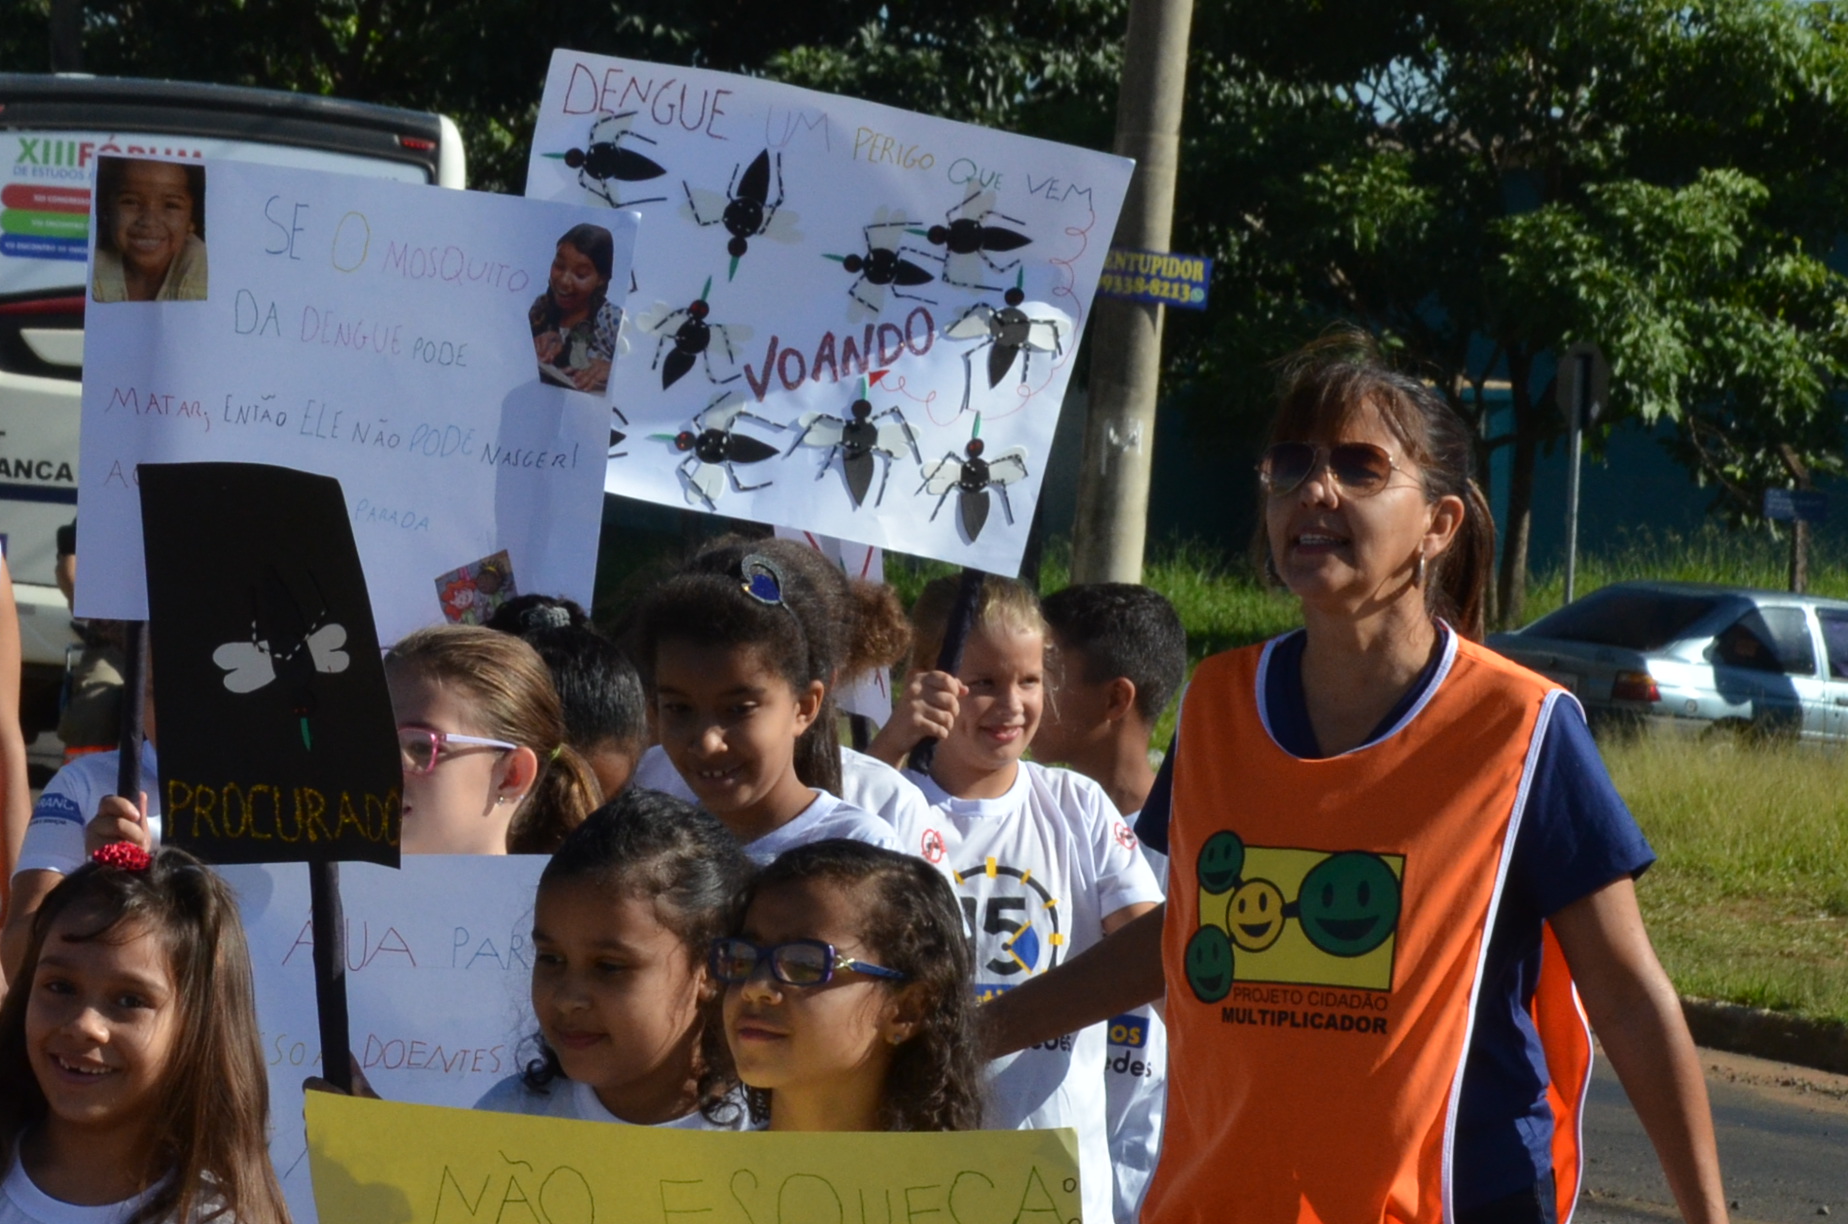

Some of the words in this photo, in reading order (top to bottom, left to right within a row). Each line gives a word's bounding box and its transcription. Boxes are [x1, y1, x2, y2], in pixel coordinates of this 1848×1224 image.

[563, 62, 732, 140] DENGUE
[765, 105, 831, 152] UM
[852, 127, 936, 171] PERIGO
[948, 158, 1004, 192] QUE
[1027, 173, 1094, 211] VEM
[265, 195, 310, 260] SE
[331, 210, 371, 273] O
[381, 240, 530, 293] MOSQUITO
[234, 288, 282, 337] DA
[300, 304, 403, 356] DENGUE
[413, 336, 468, 368] PODE
[744, 306, 936, 402] VOANDO
[224, 394, 288, 429] ENTÃO
[300, 399, 340, 440] ELE
[352, 418, 401, 450] NÃO
[409, 421, 474, 460] PODE
[167, 778, 402, 844] PROCURADO
[1221, 1007, 1389, 1035] MULTIPLICADOR
[1233, 986, 1303, 1006] PROJETO
[1307, 990, 1389, 1012] CIDADÃO
[363, 1033, 506, 1074] DOENTES
